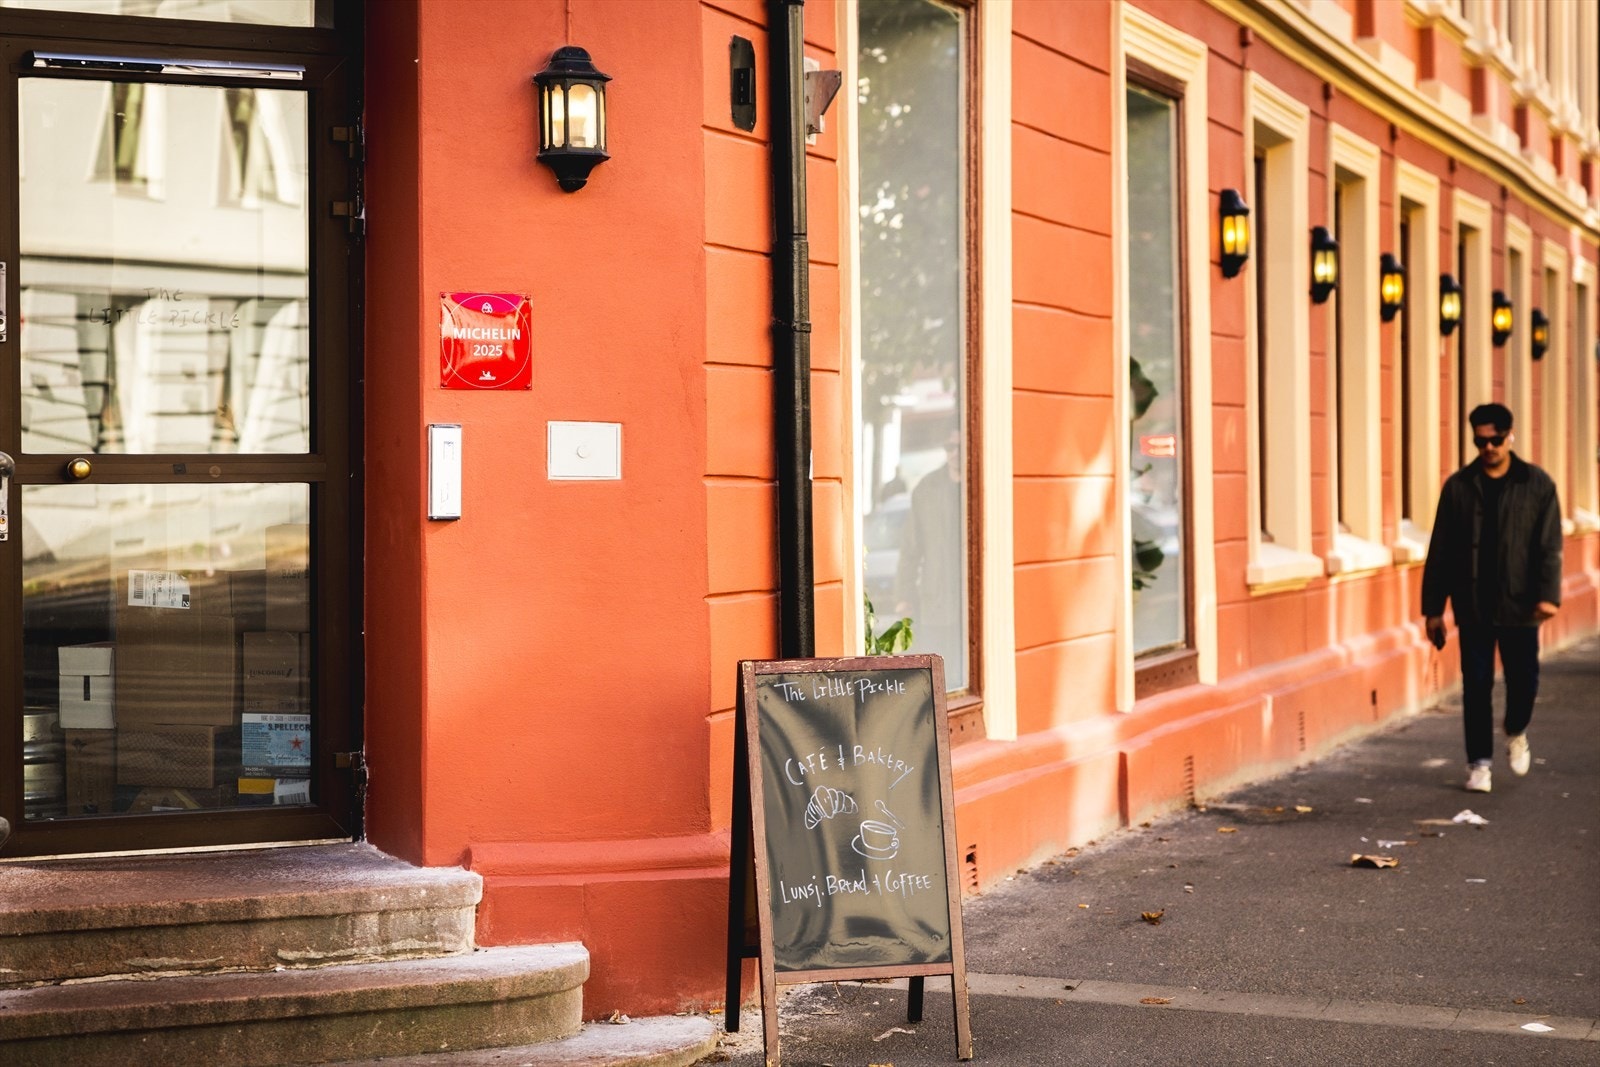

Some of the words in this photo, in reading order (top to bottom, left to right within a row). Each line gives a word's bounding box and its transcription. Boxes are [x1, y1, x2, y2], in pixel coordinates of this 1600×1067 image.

[168, 309, 240, 329] PICKLE
[453, 327, 521, 340] MICHELIN
[473, 344, 503, 357] 2025
[774, 681, 806, 702] The
